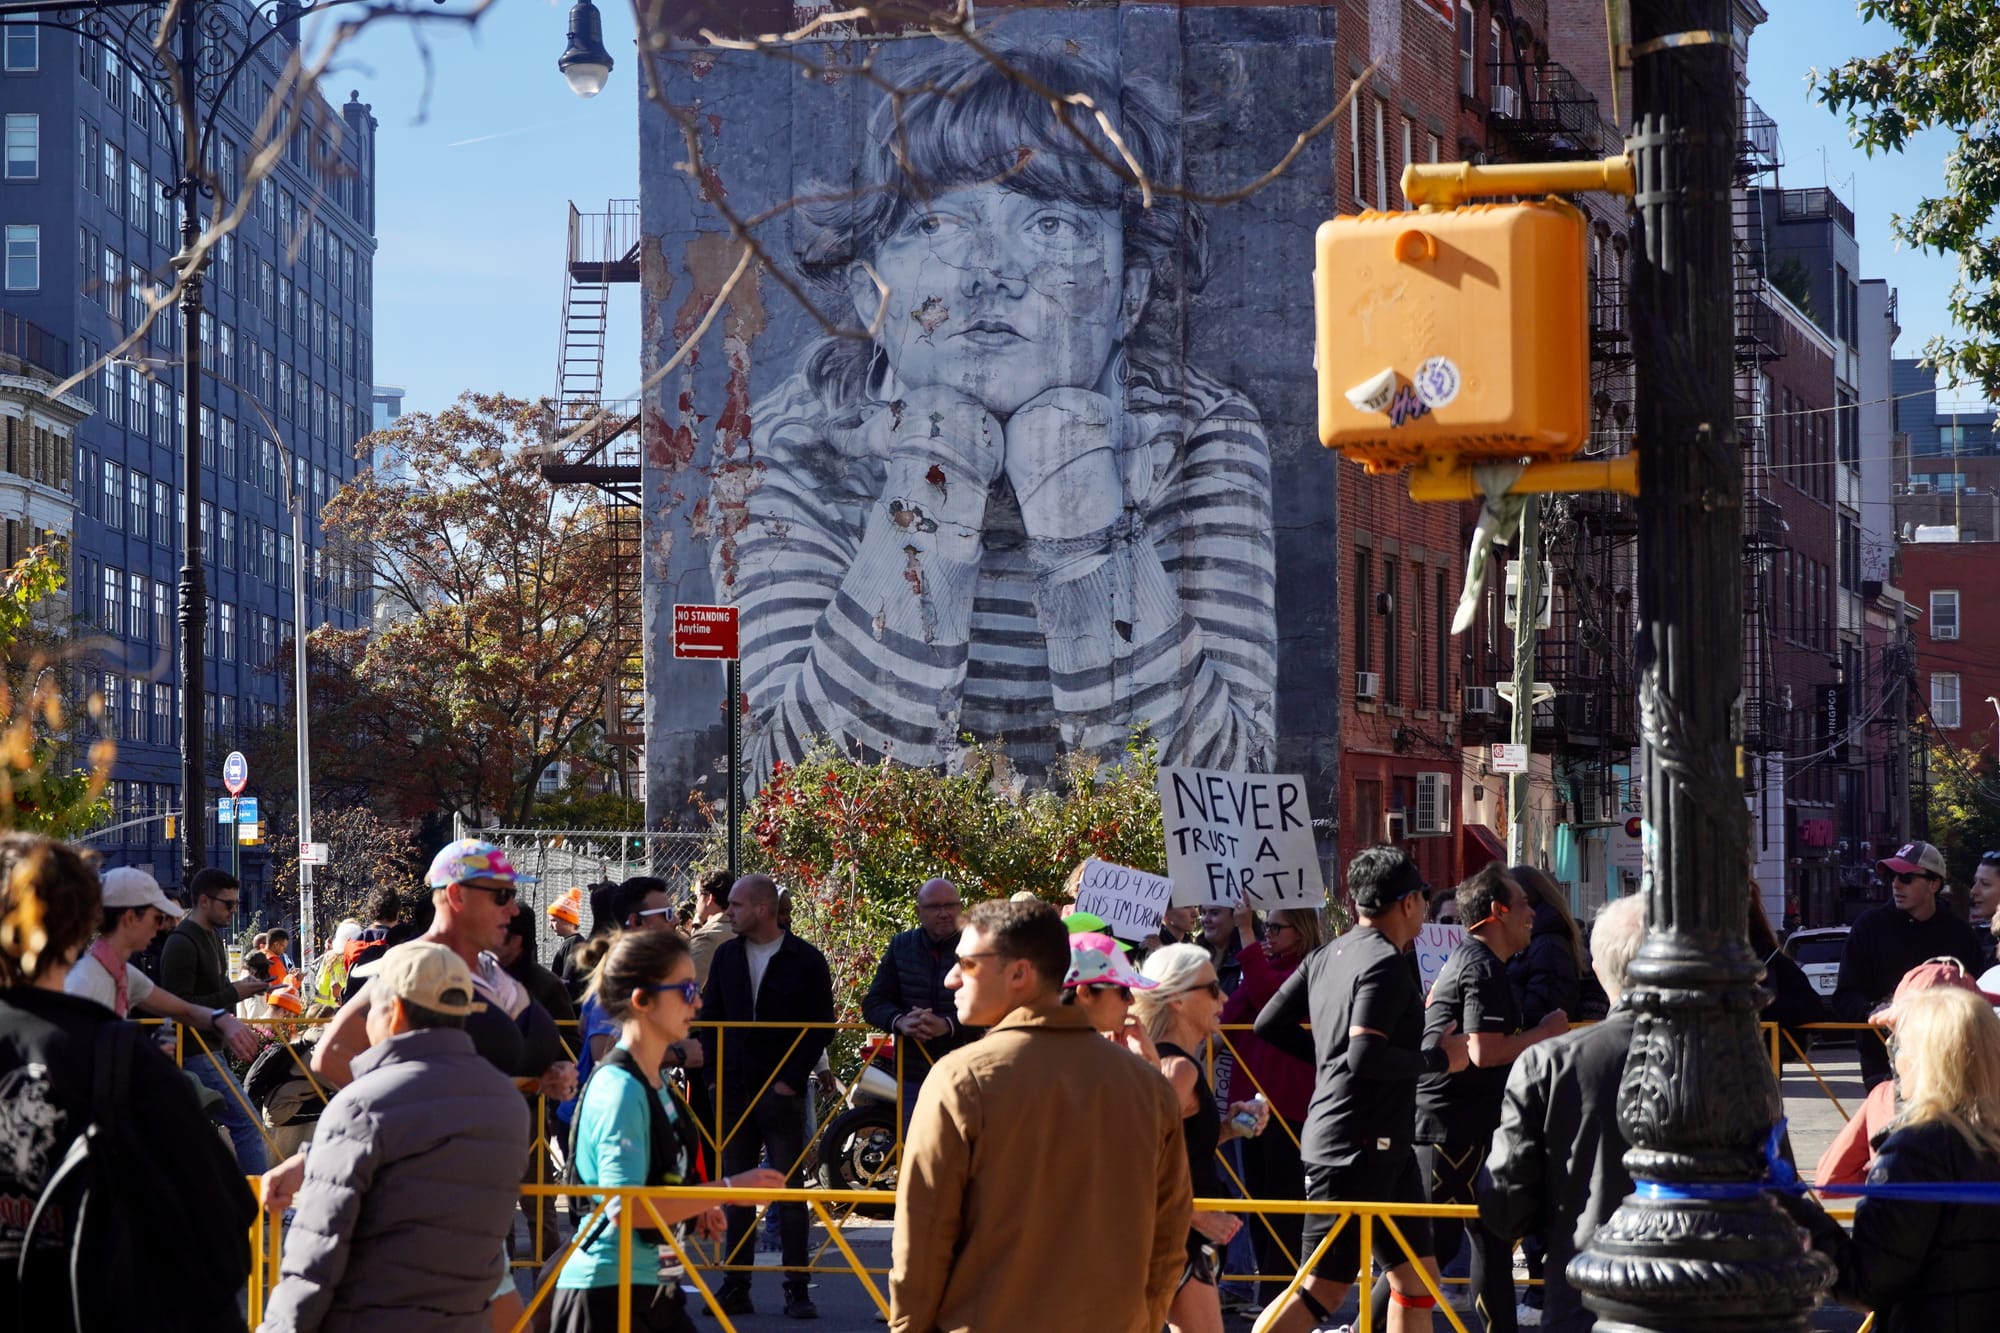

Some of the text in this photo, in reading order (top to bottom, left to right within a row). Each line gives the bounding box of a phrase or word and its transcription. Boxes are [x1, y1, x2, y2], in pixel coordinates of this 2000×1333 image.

[677, 610, 730, 622] NO STANDING
[678, 623, 711, 635] Anytime
[1172, 772, 1304, 832] NEVER
[1172, 827, 1280, 862] TRUST A
[1083, 861, 1171, 900] GOOD 4 YOU
[1206, 863, 1304, 900] FART!
[1075, 890, 1108, 916] GUYS
